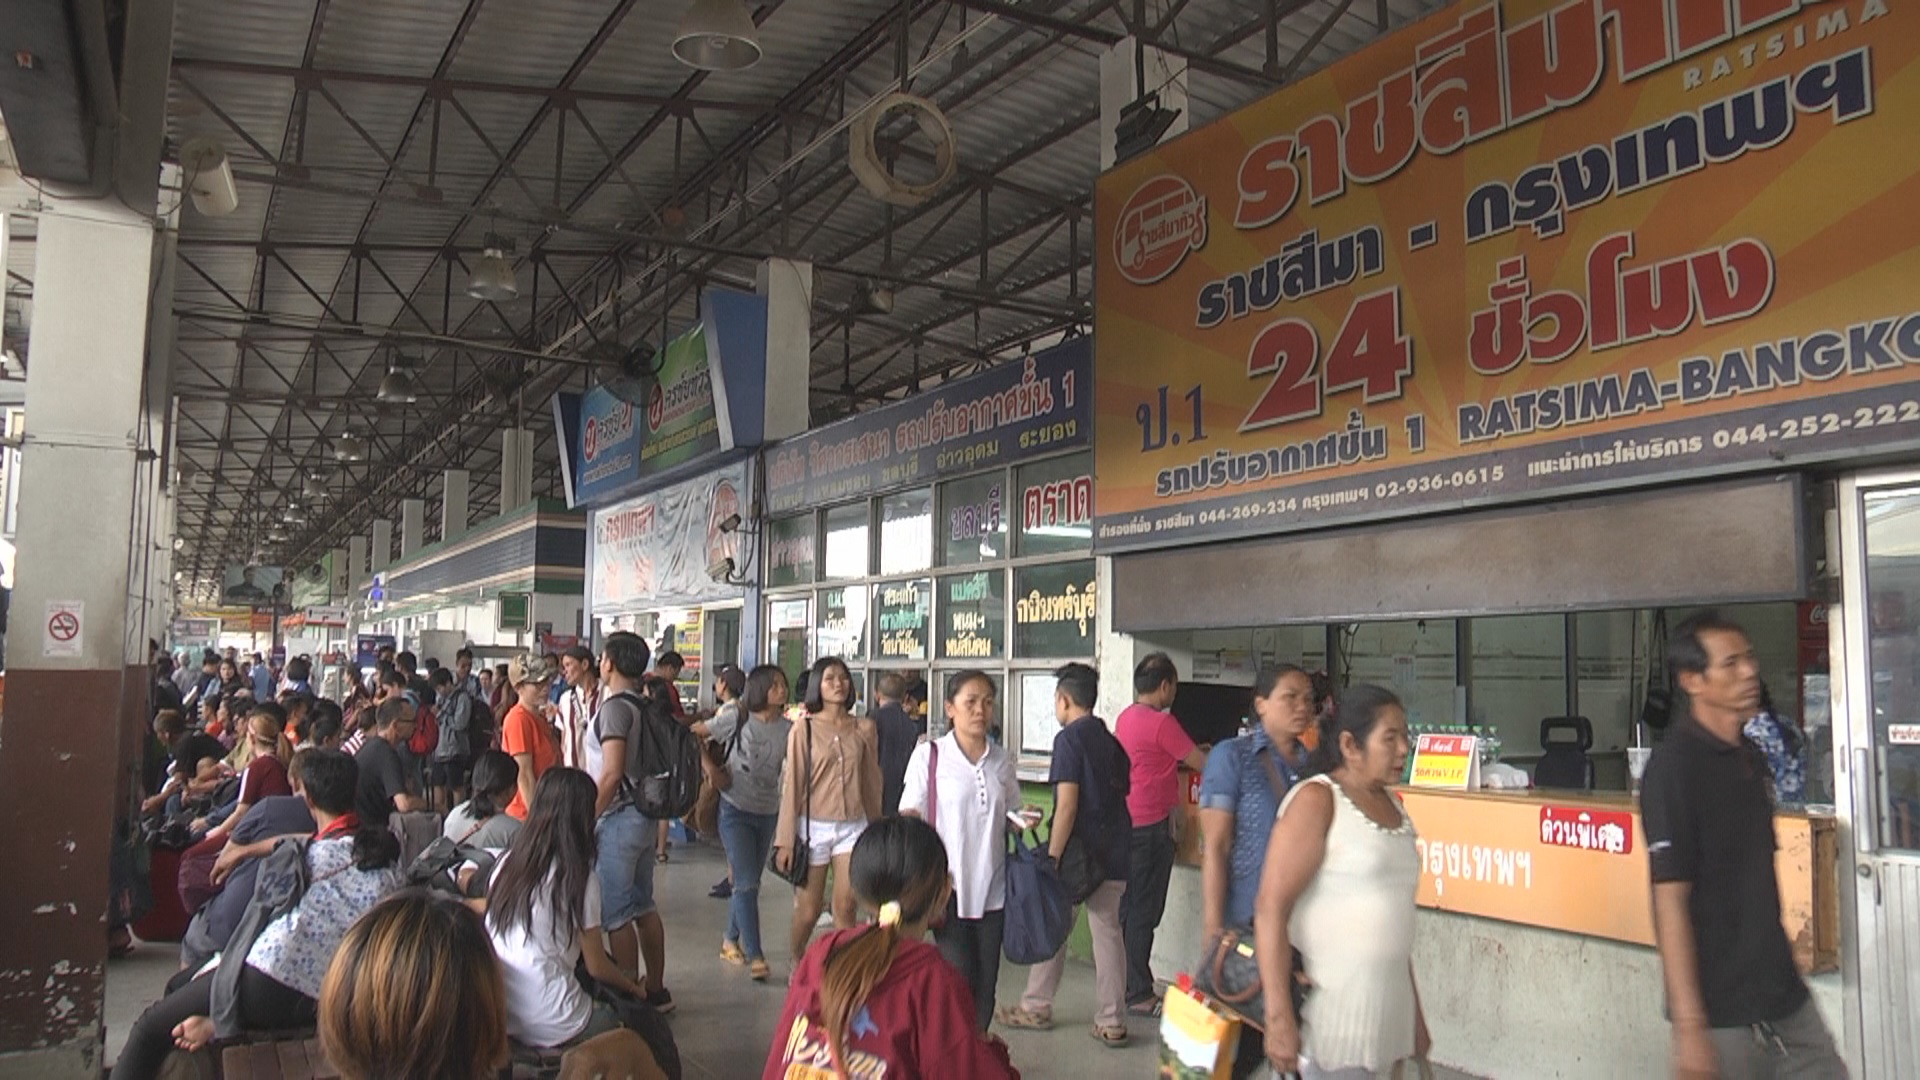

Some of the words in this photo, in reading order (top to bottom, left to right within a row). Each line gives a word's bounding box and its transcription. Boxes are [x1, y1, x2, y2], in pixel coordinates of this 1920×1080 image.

[1683, 0, 1890, 91] RATSIMA
[1196, 229, 1384, 328] ราชสีมา
[1464, 46, 1875, 246] กรุงเทพฯ
[1238, 286, 1413, 434] 24
[1468, 231, 1775, 375] ชั่วโมง
[895, 356, 1054, 454] รถปรับอากาศชั้น
[1062, 369, 1076, 408] 1
[936, 439, 999, 468] อ่าวอุดม
[1019, 419, 1077, 449] ระยอง
[1136, 384, 1208, 452] ป.1
[1100, 515, 1152, 538] สำรองที่นั่ง
[1155, 513, 1195, 531] ราชสีมา
[1199, 498, 1297, 525] 044-269-234
[1302, 486, 1369, 513] กรุงเทพฯ
[1375, 465, 1504, 498] 02-936-0615
[1528, 438, 1703, 477] แนะนำการให้บริการ
[1713, 401, 1920, 448] 044-252-222
[1155, 409, 1386, 497] รถปรับอากาศชั้น
[1404, 415, 1425, 453] 1
[1023, 475, 1092, 530] ตราด
[1016, 581, 1095, 637] กบินทร์บุรี
